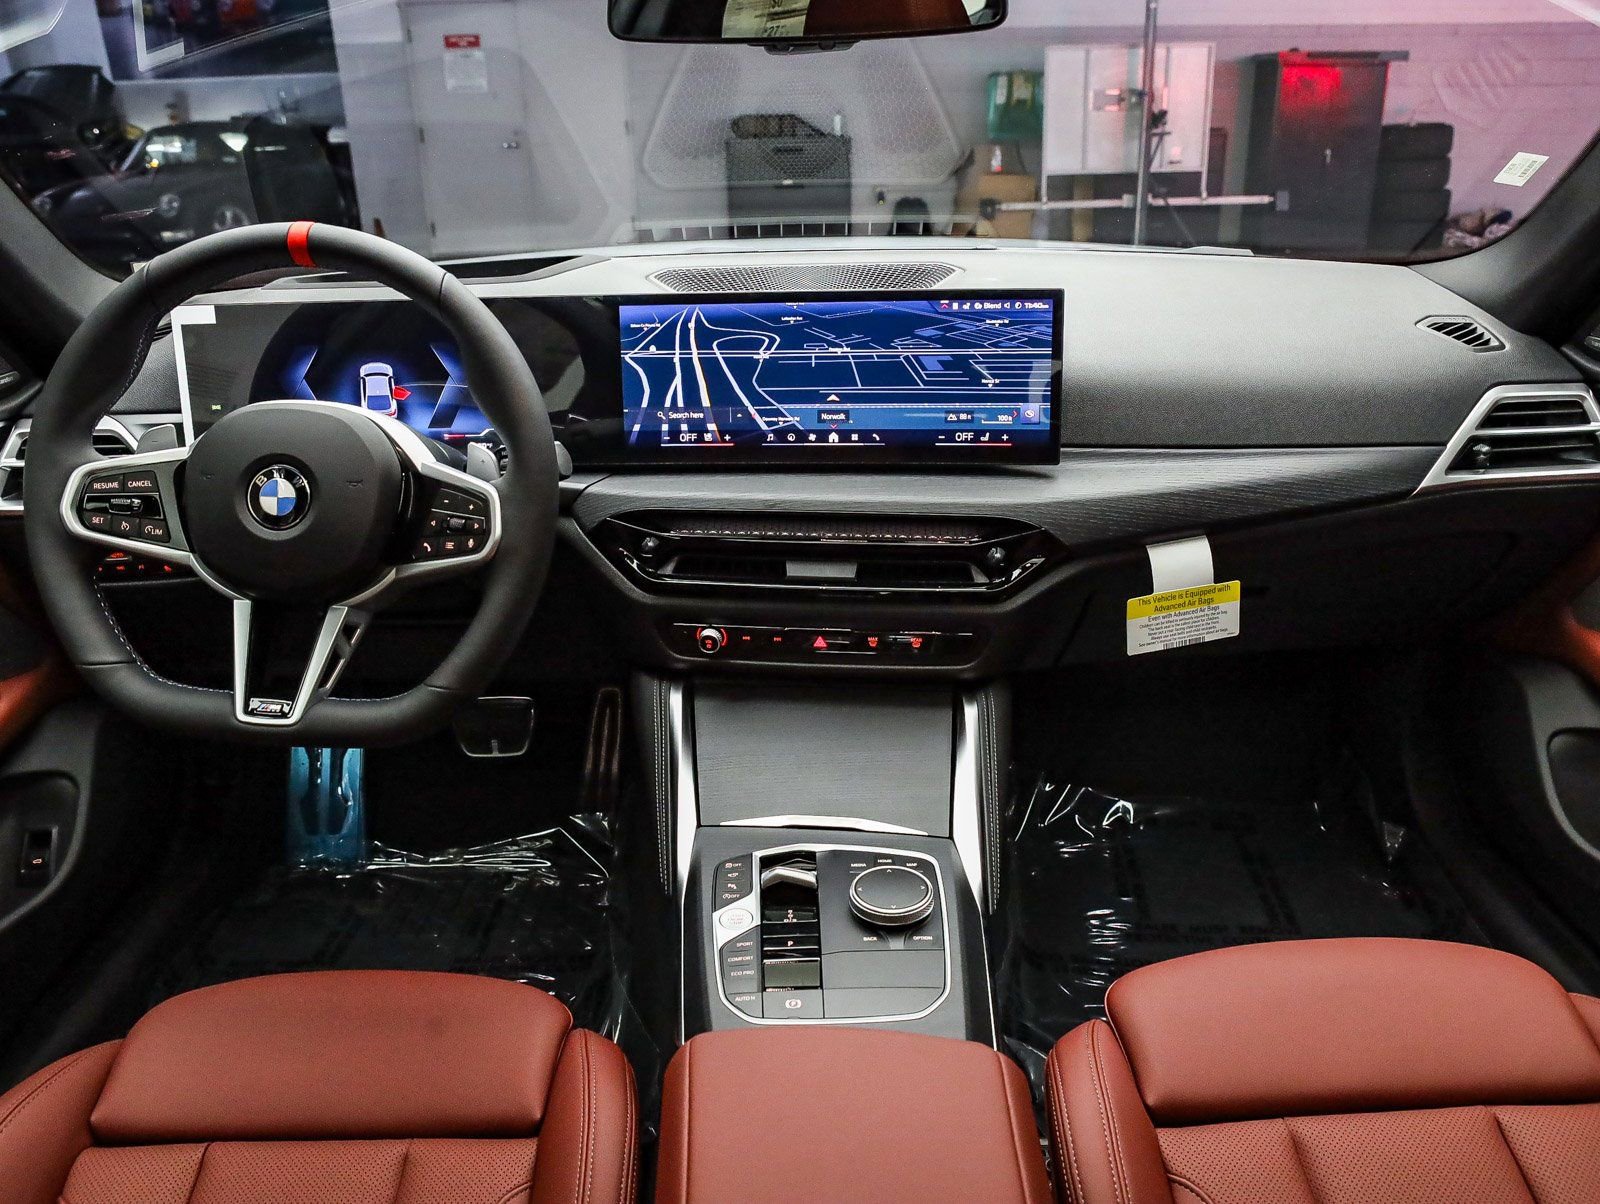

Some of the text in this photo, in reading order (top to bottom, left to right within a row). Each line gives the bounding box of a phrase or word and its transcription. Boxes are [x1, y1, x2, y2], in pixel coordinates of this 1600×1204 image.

[668, 412, 692, 420] Search
[821, 412, 846, 421] Norwalk
[679, 433, 698, 442] OFF
[955, 432, 974, 441] OFF
[255, 469, 304, 488] BMW
[93, 480, 152, 490] RESUME CANCEL
[92, 516, 104, 524] SET
[1153, 594, 1176, 603] Vehicle
[1186, 587, 1216, 599] Equipped
[1154, 601, 1186, 612] Advanced
[1199, 596, 1214, 605] Bags
[1174, 609, 1198, 617] Advanced
